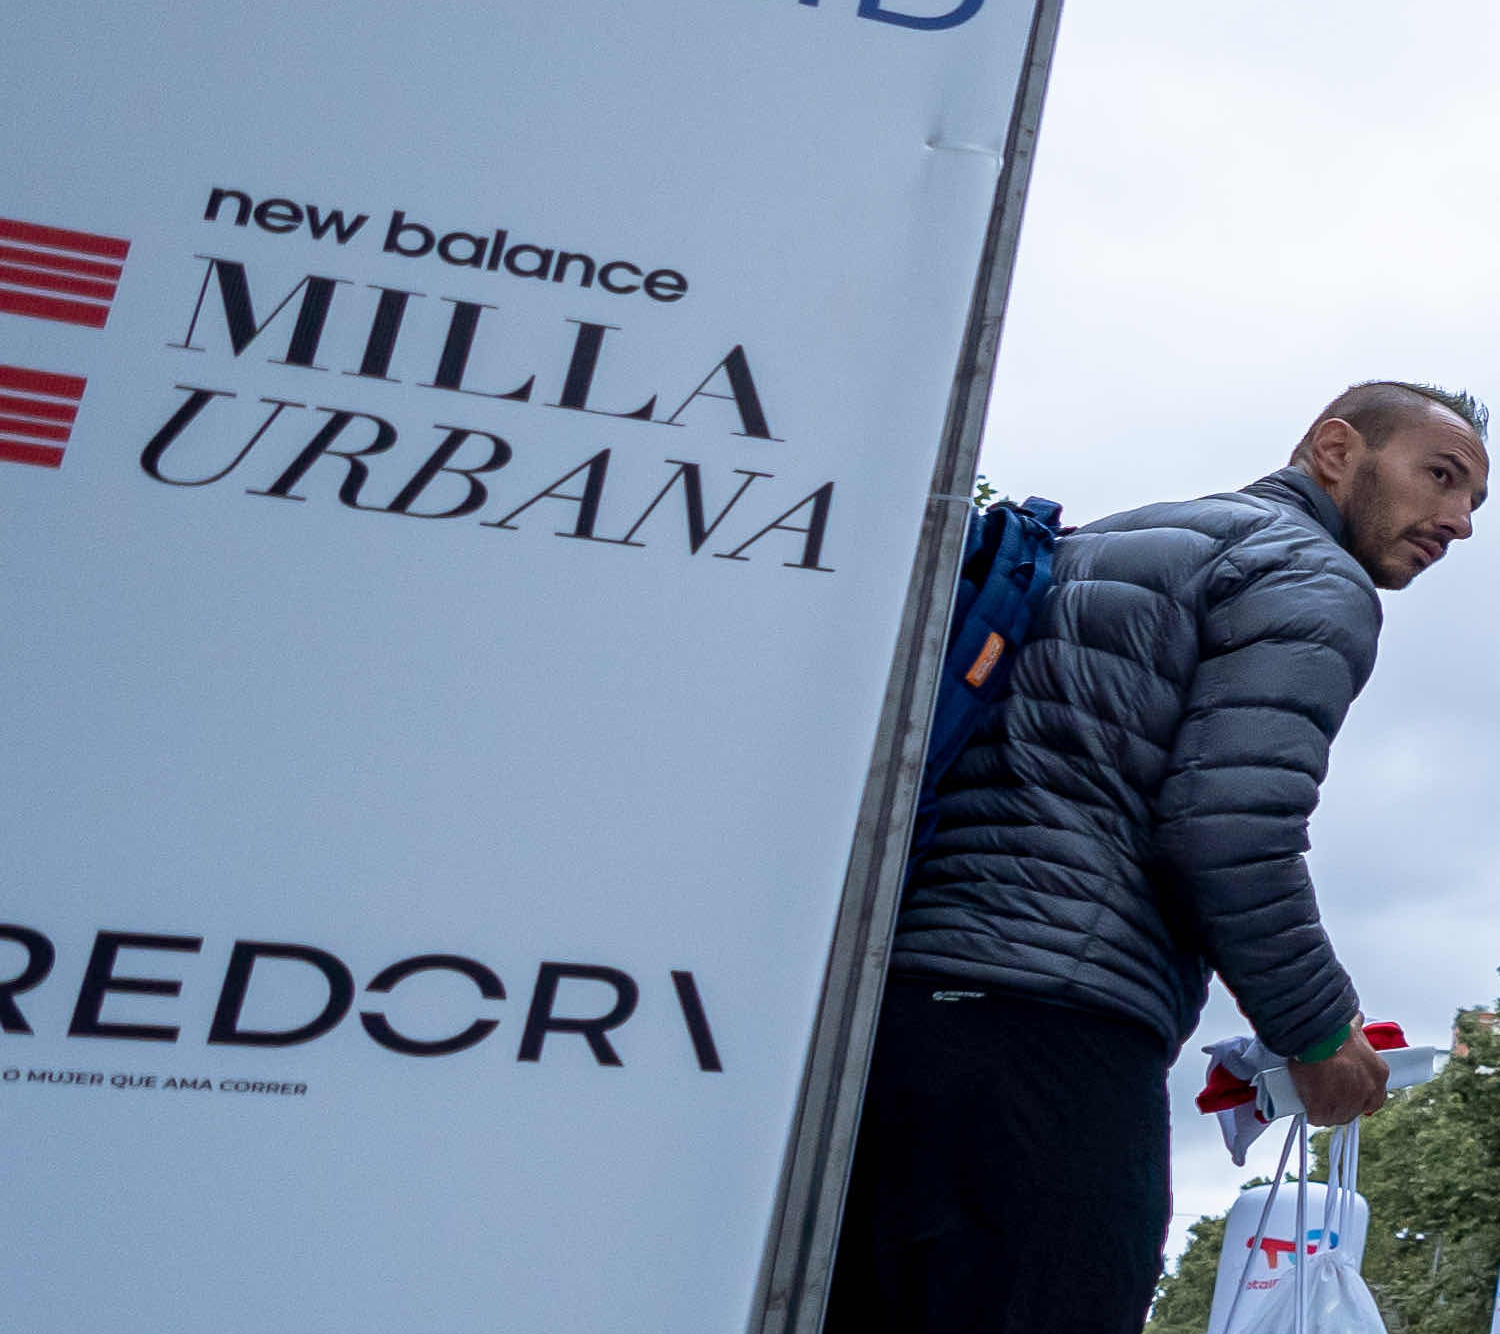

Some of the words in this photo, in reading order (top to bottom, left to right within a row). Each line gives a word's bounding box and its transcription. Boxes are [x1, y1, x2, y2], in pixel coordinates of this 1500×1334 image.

[203, 185, 369, 247] new
[381, 210, 690, 305] balance
[163, 253, 789, 445] MILLA
[138, 383, 840, 574] URBANA
[27, 1069, 104, 1086] MUJER
[110, 1074, 157, 1091] QUE
[163, 1076, 214, 1093] AMA
[218, 1079, 309, 1097] CORRER
